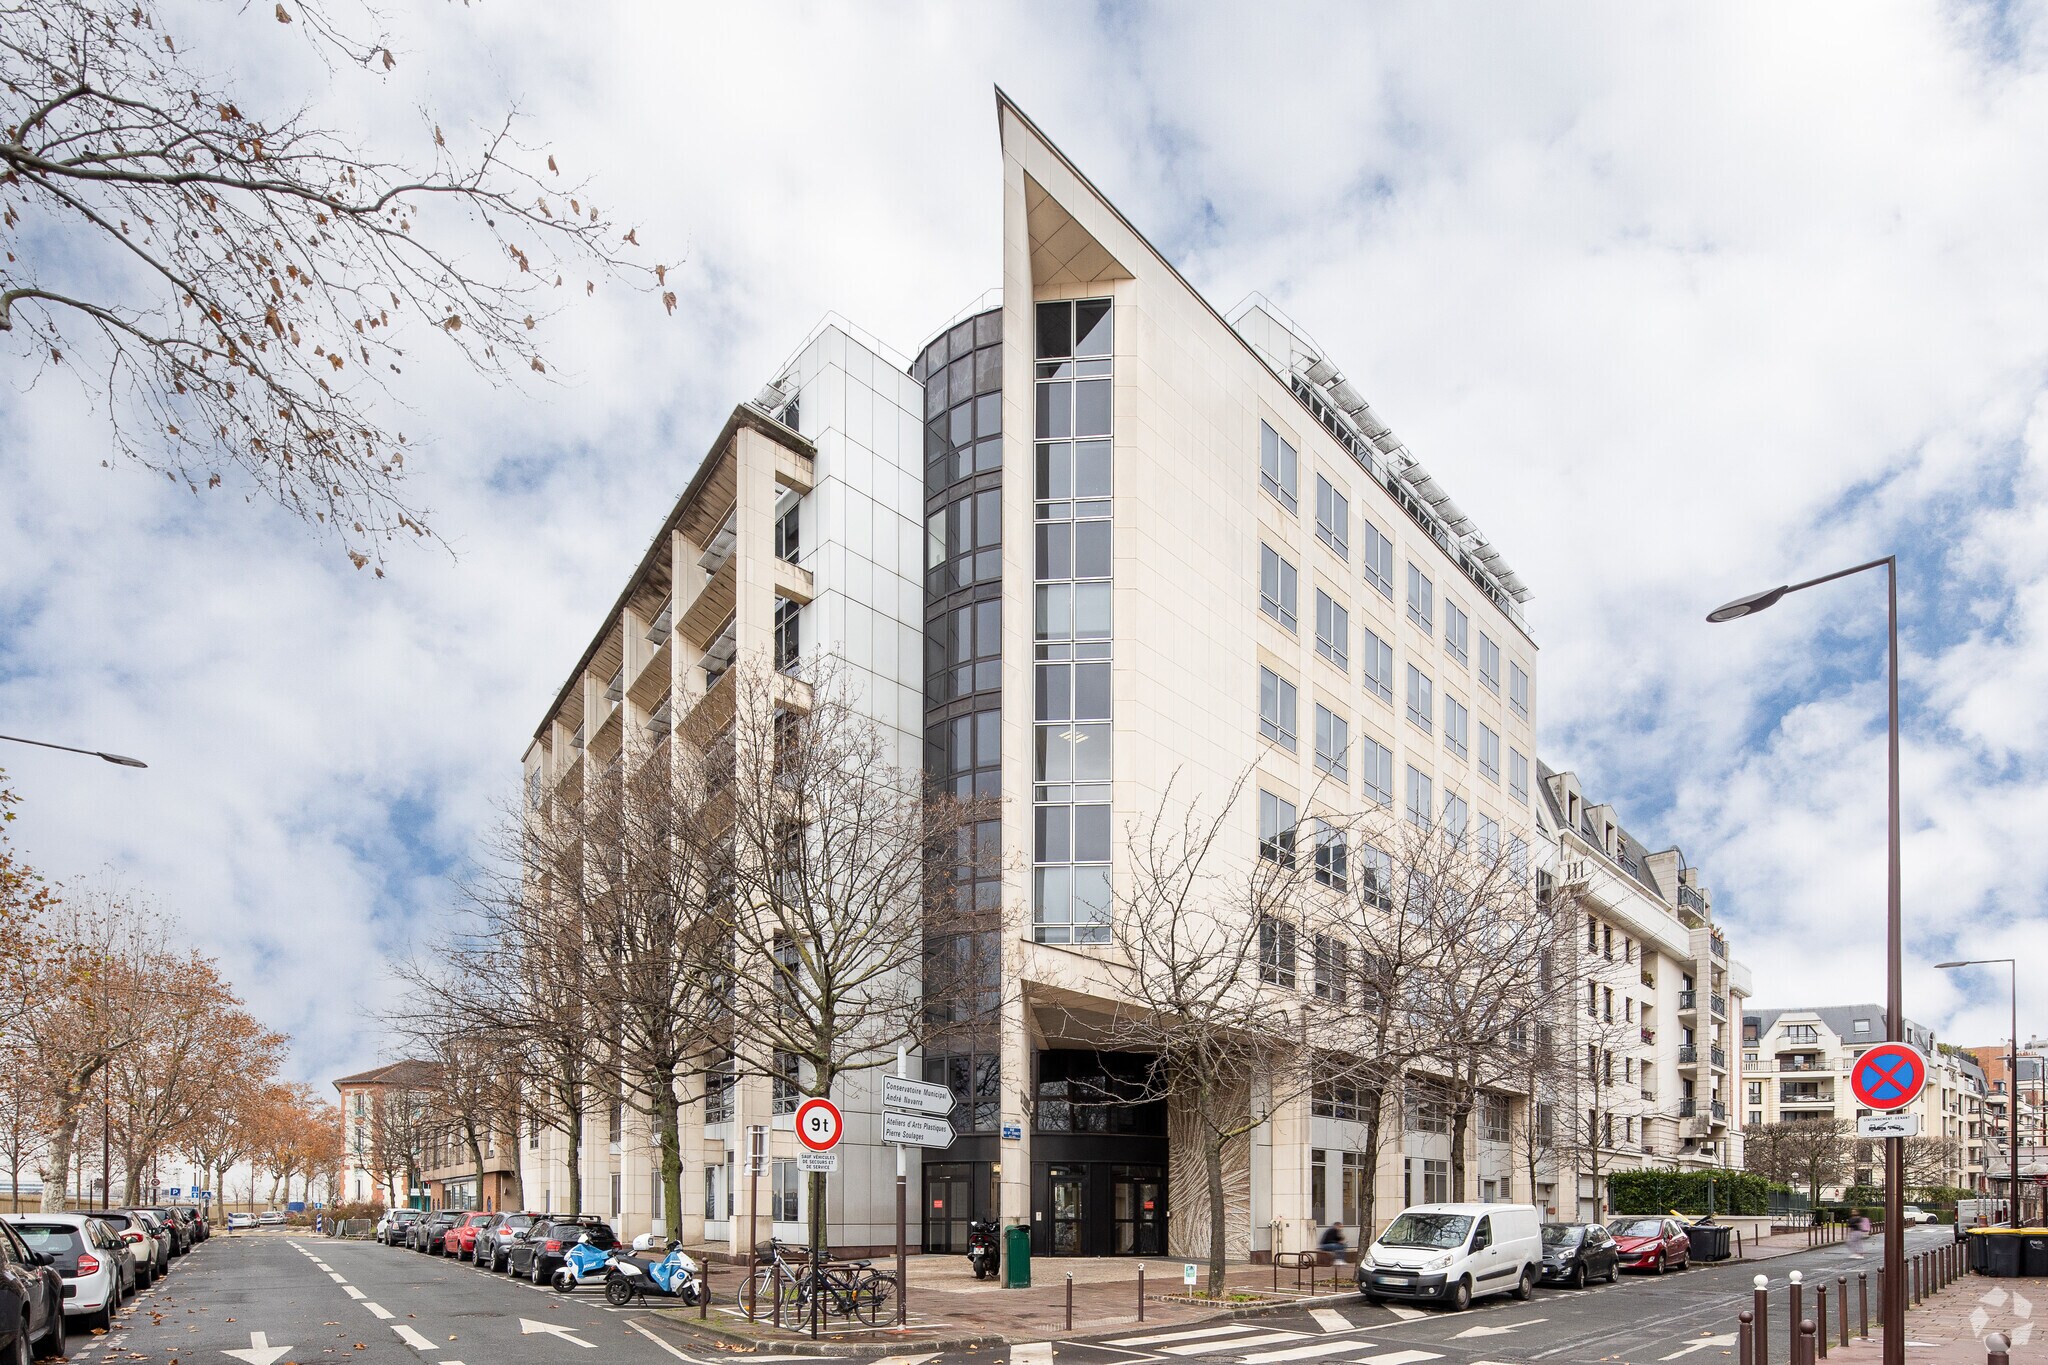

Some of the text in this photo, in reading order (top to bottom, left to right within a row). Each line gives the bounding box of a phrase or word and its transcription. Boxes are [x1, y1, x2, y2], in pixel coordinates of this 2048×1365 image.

[886, 1082, 948, 1100] Conservatoire Municipal
[886, 1093, 923, 1106] André Navarra
[886, 1118, 906, 1127] Ateliers
[924, 1123, 947, 1133] Plastiques
[886, 1129, 924, 1141] Pierre Soulages
